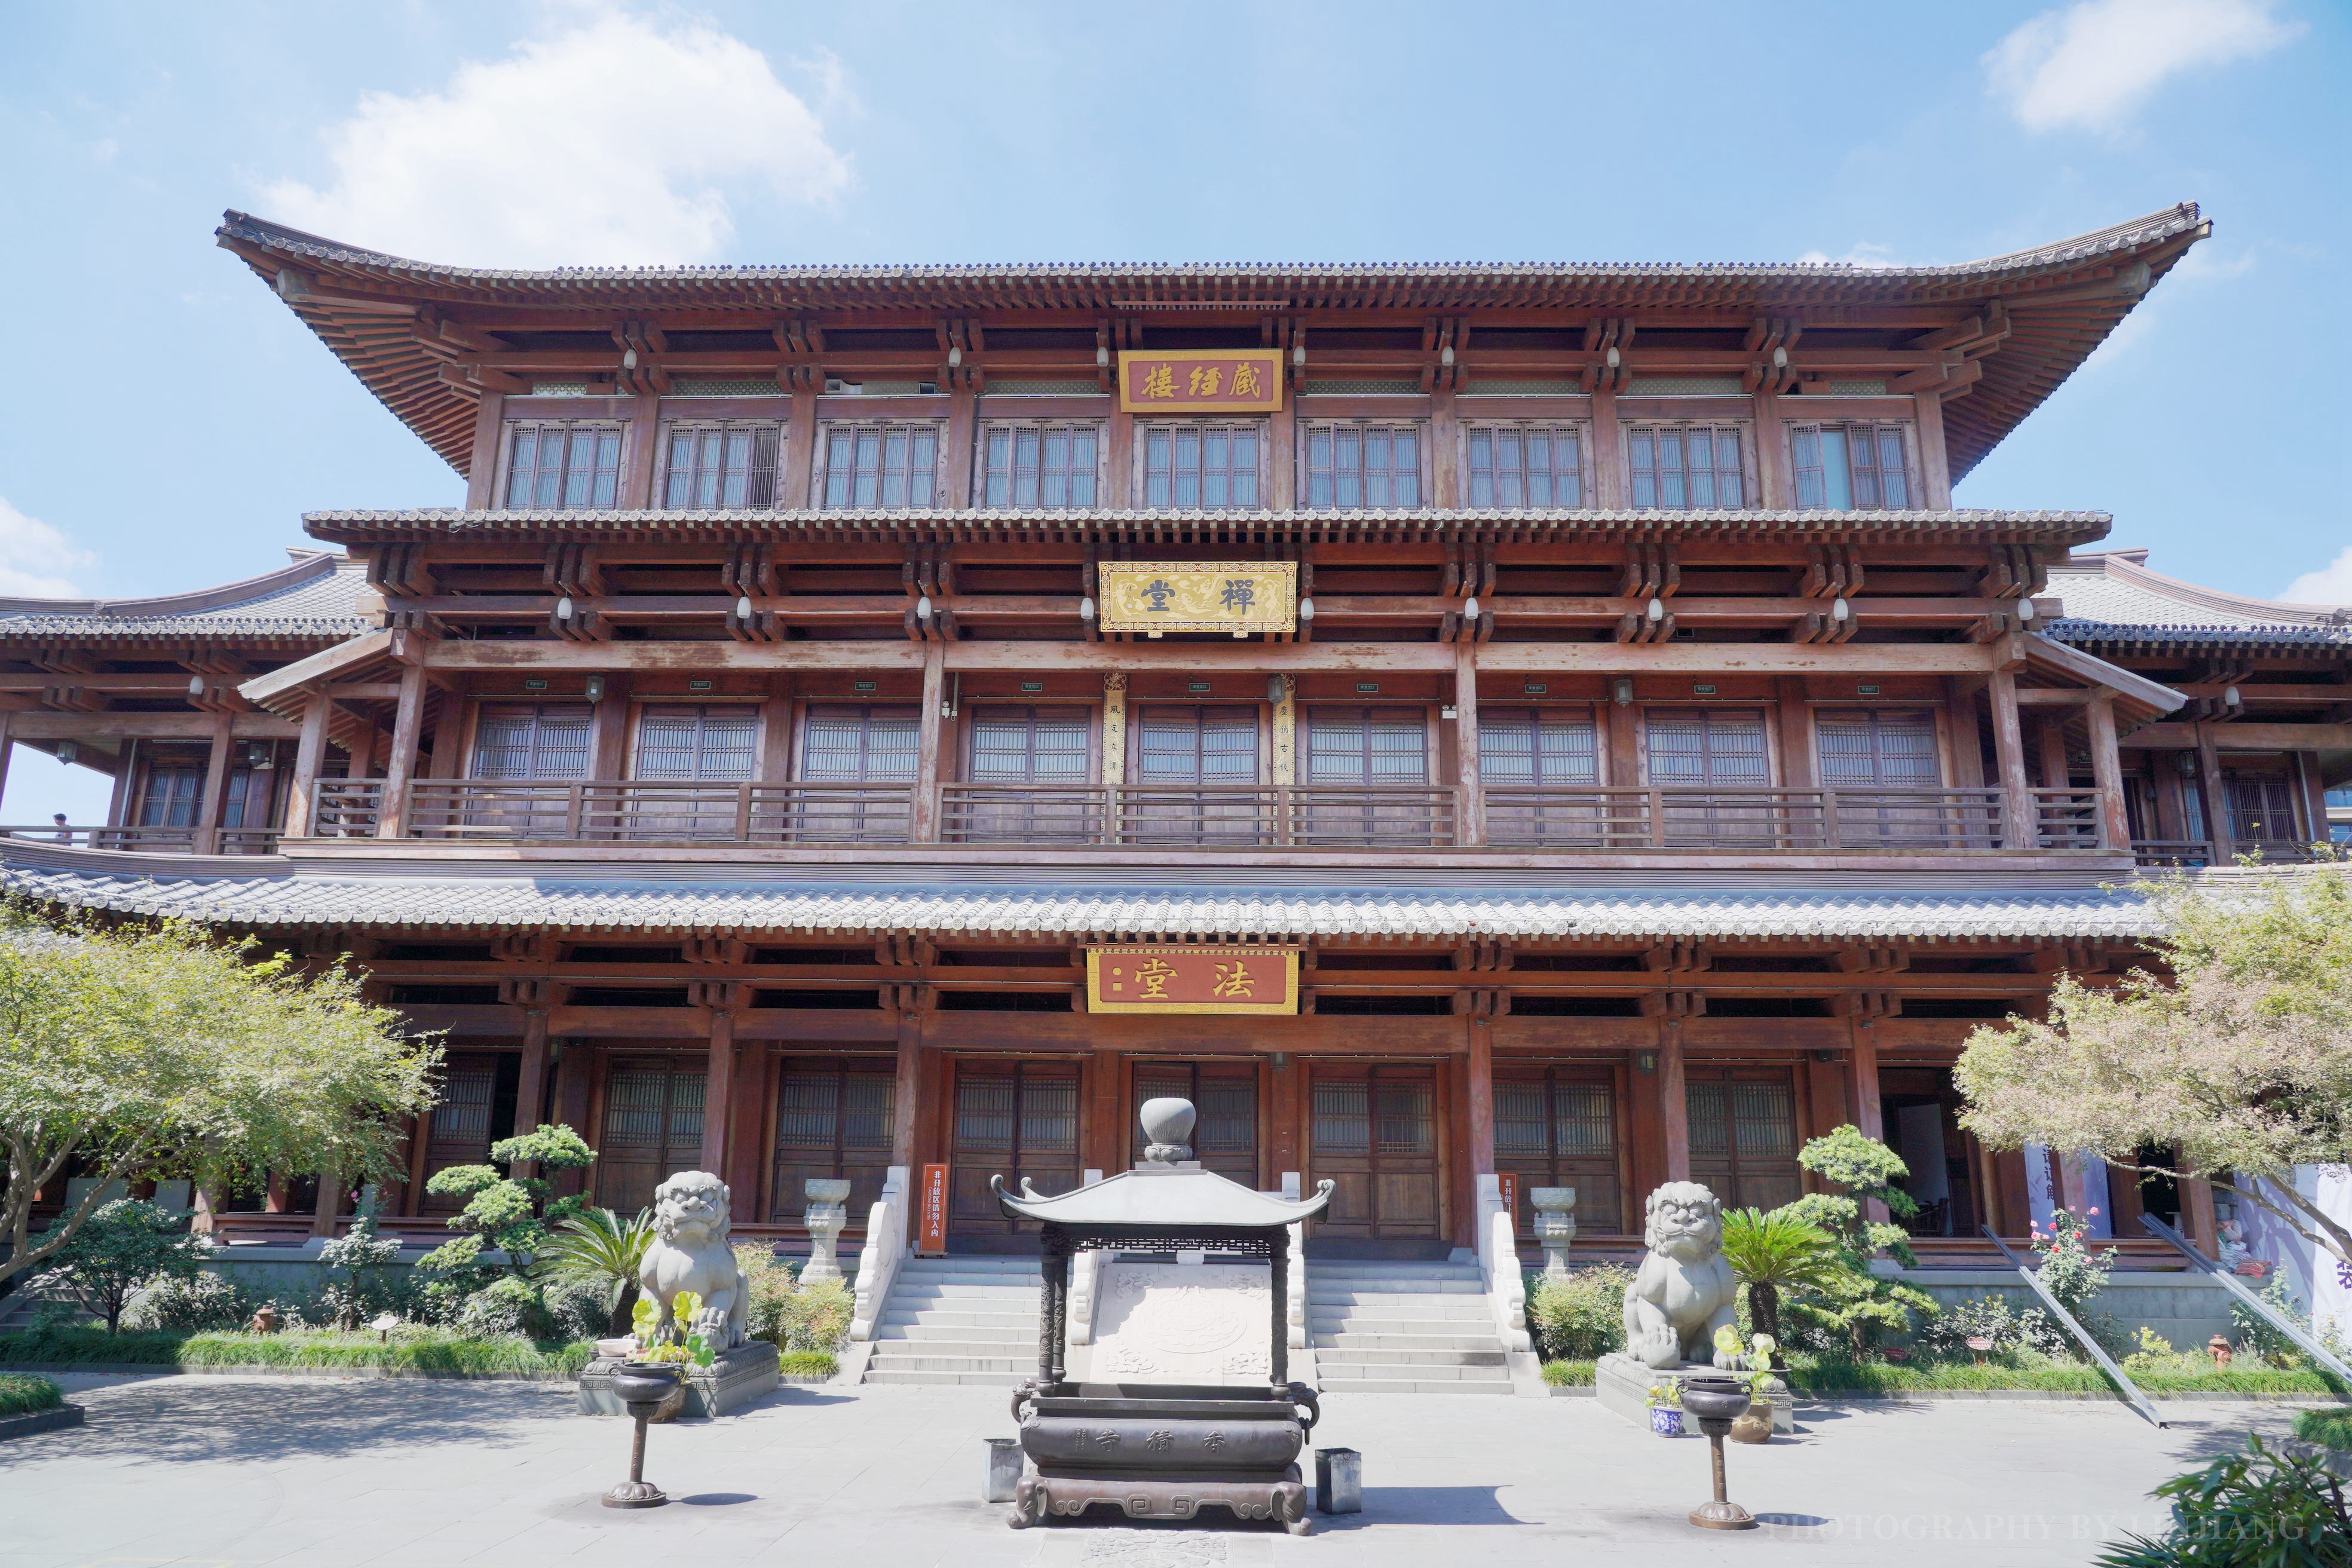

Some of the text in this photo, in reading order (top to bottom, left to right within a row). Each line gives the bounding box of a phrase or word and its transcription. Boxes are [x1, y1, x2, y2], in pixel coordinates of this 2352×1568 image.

[1141, 579, 1255, 615] 禪堂
[1135, 957, 1255, 999] 法堂
[931, 1171, 941, 1237] 非开放区请勿入内
[1096, 1428, 1226, 1453] 香積寺
